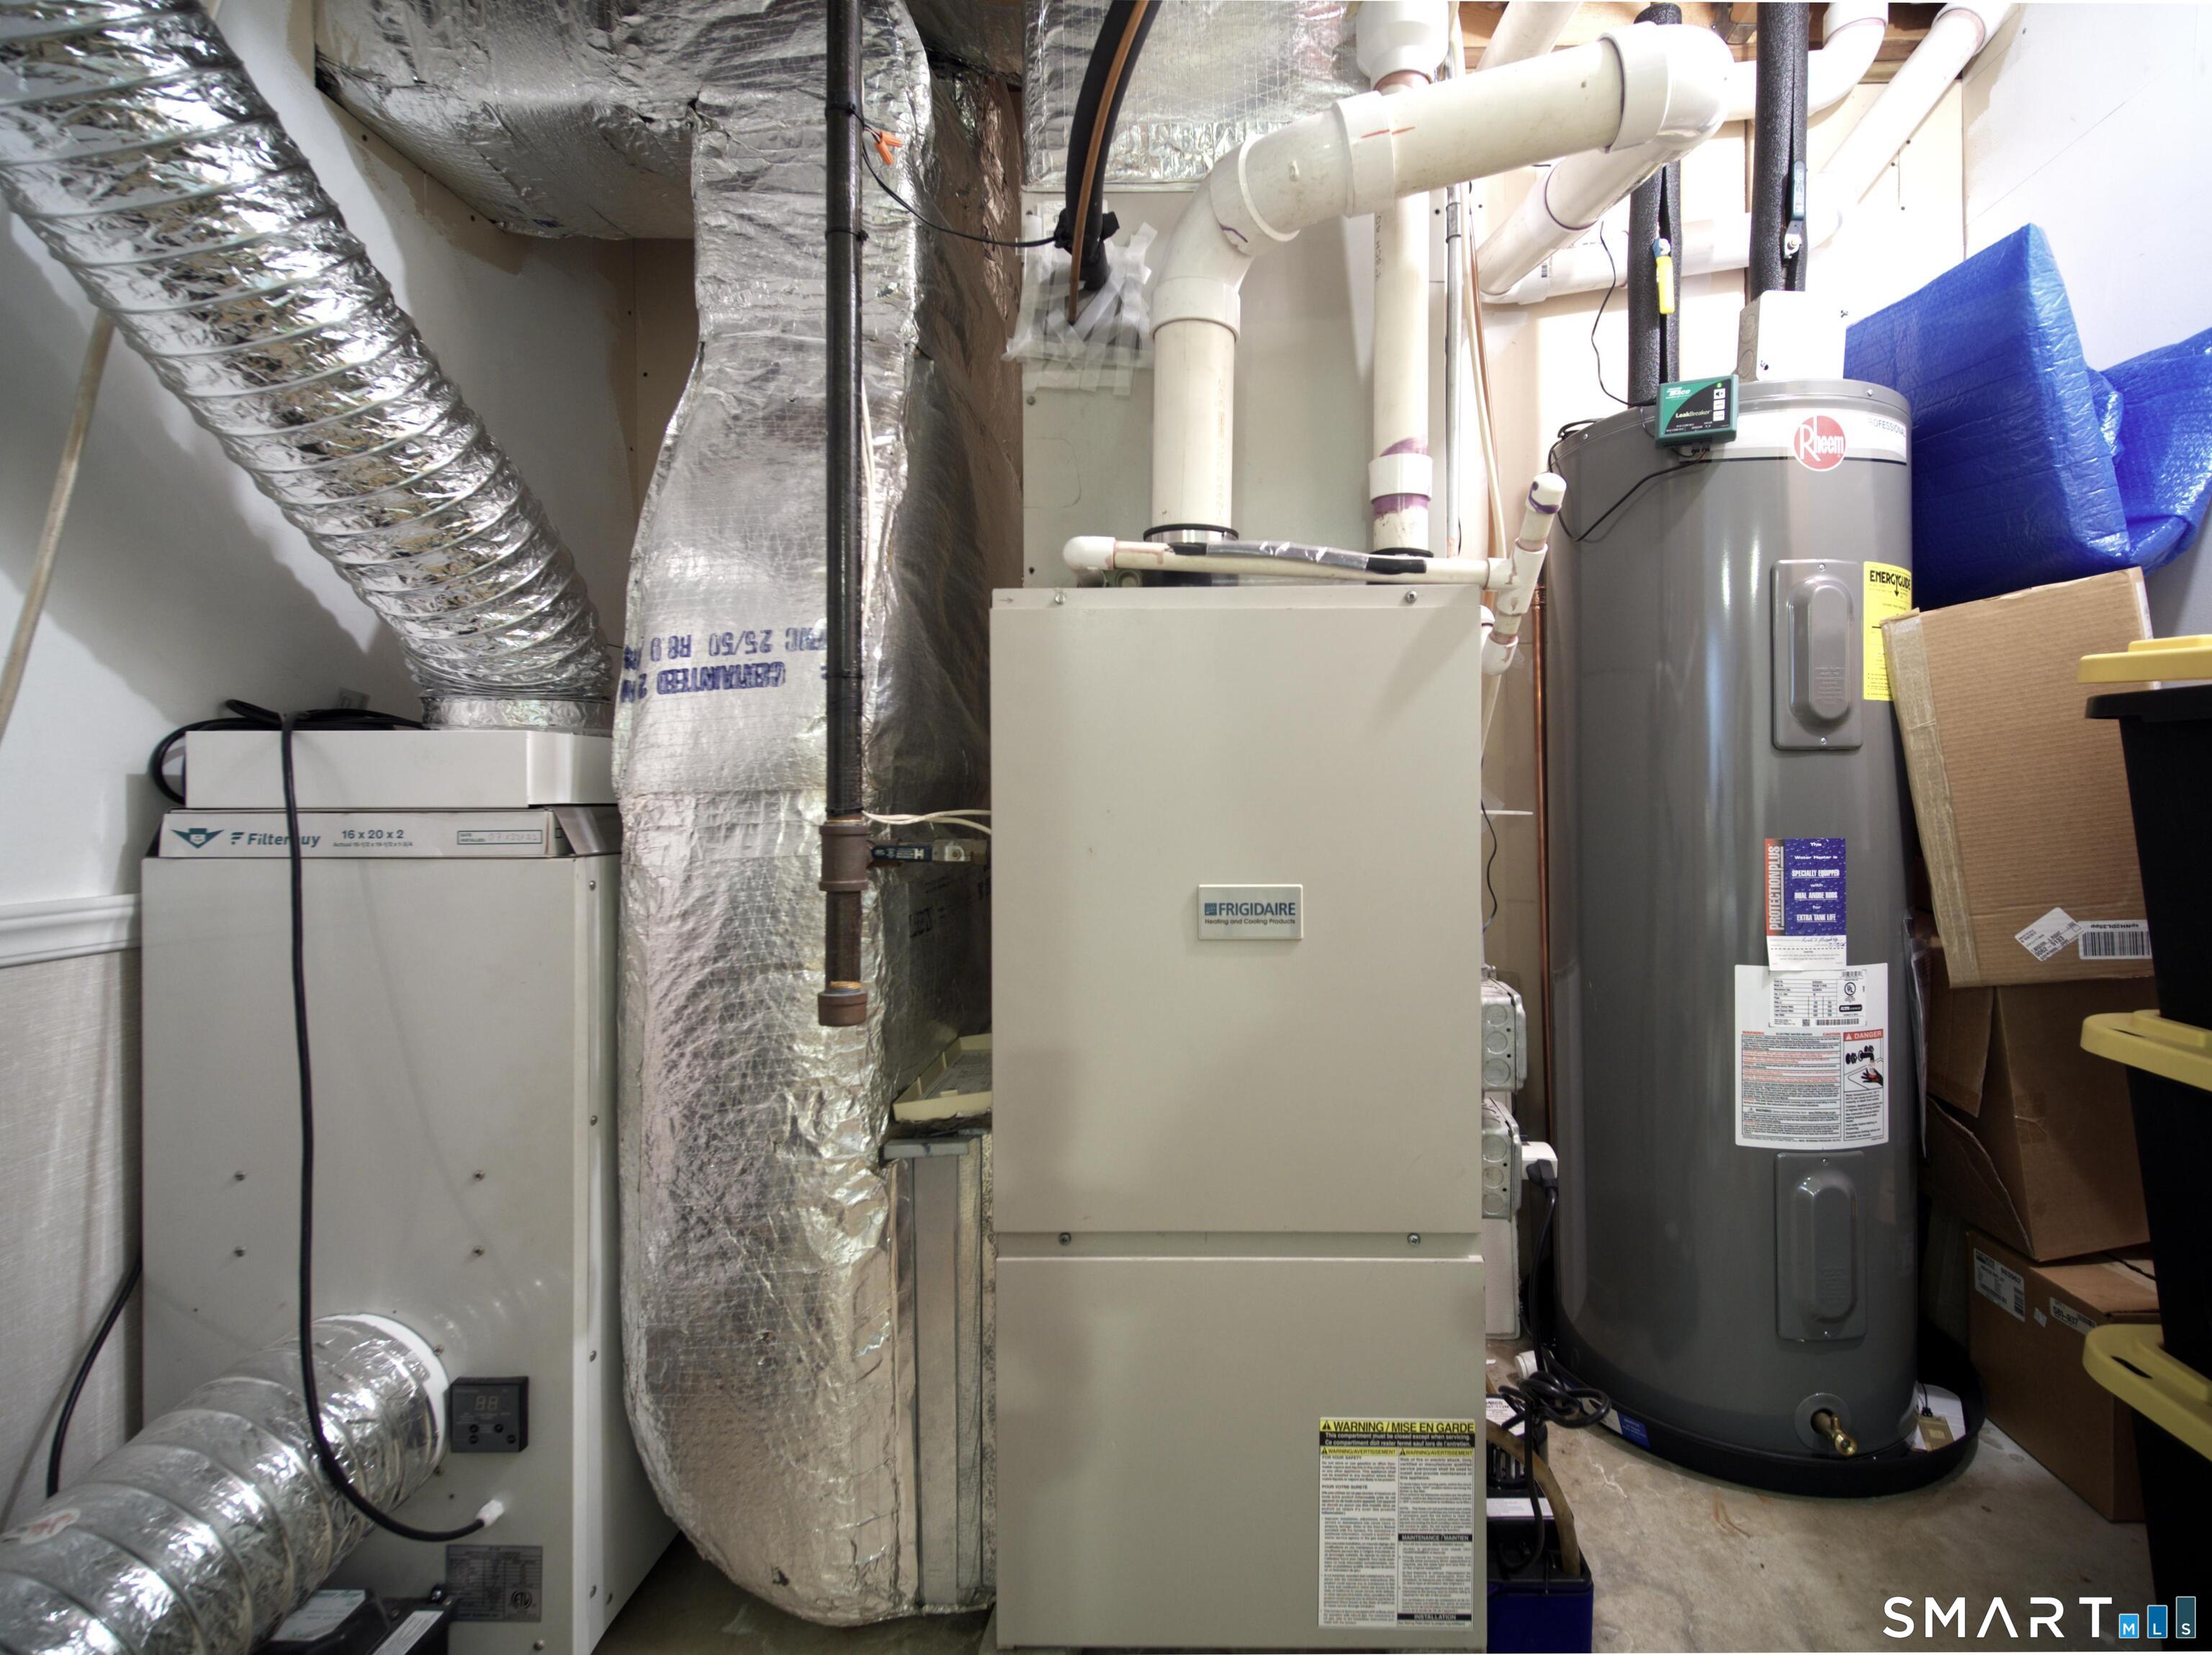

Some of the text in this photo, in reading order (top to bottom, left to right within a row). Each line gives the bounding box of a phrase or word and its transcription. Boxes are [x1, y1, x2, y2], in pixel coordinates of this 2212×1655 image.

[1675, 410, 1711, 418] LeakBreaker
[1868, 418, 1907, 438] ROFESSIONAL
[1799, 415, 1845, 461] Rheem
[1869, 569, 1910, 591] ENERGYGUIDE
[709, 629, 773, 657] 25/50
[247, 832, 321, 848] Filteruy
[341, 829, 355, 839] 16
[368, 829, 384, 839] 20
[397, 829, 404, 839] 2
[1818, 869, 1840, 878] EQUIPPED
[1218, 902, 1295, 916] FRIGIDAIRE
[1854, 1031, 1882, 1040] DANGER
[1334, 1422, 1384, 1433] WARNING
[1391, 1422, 1416, 1433] MISE
[1419, 1422, 1433, 1433] EN
[1436, 1422, 1475, 1433] GARDE
